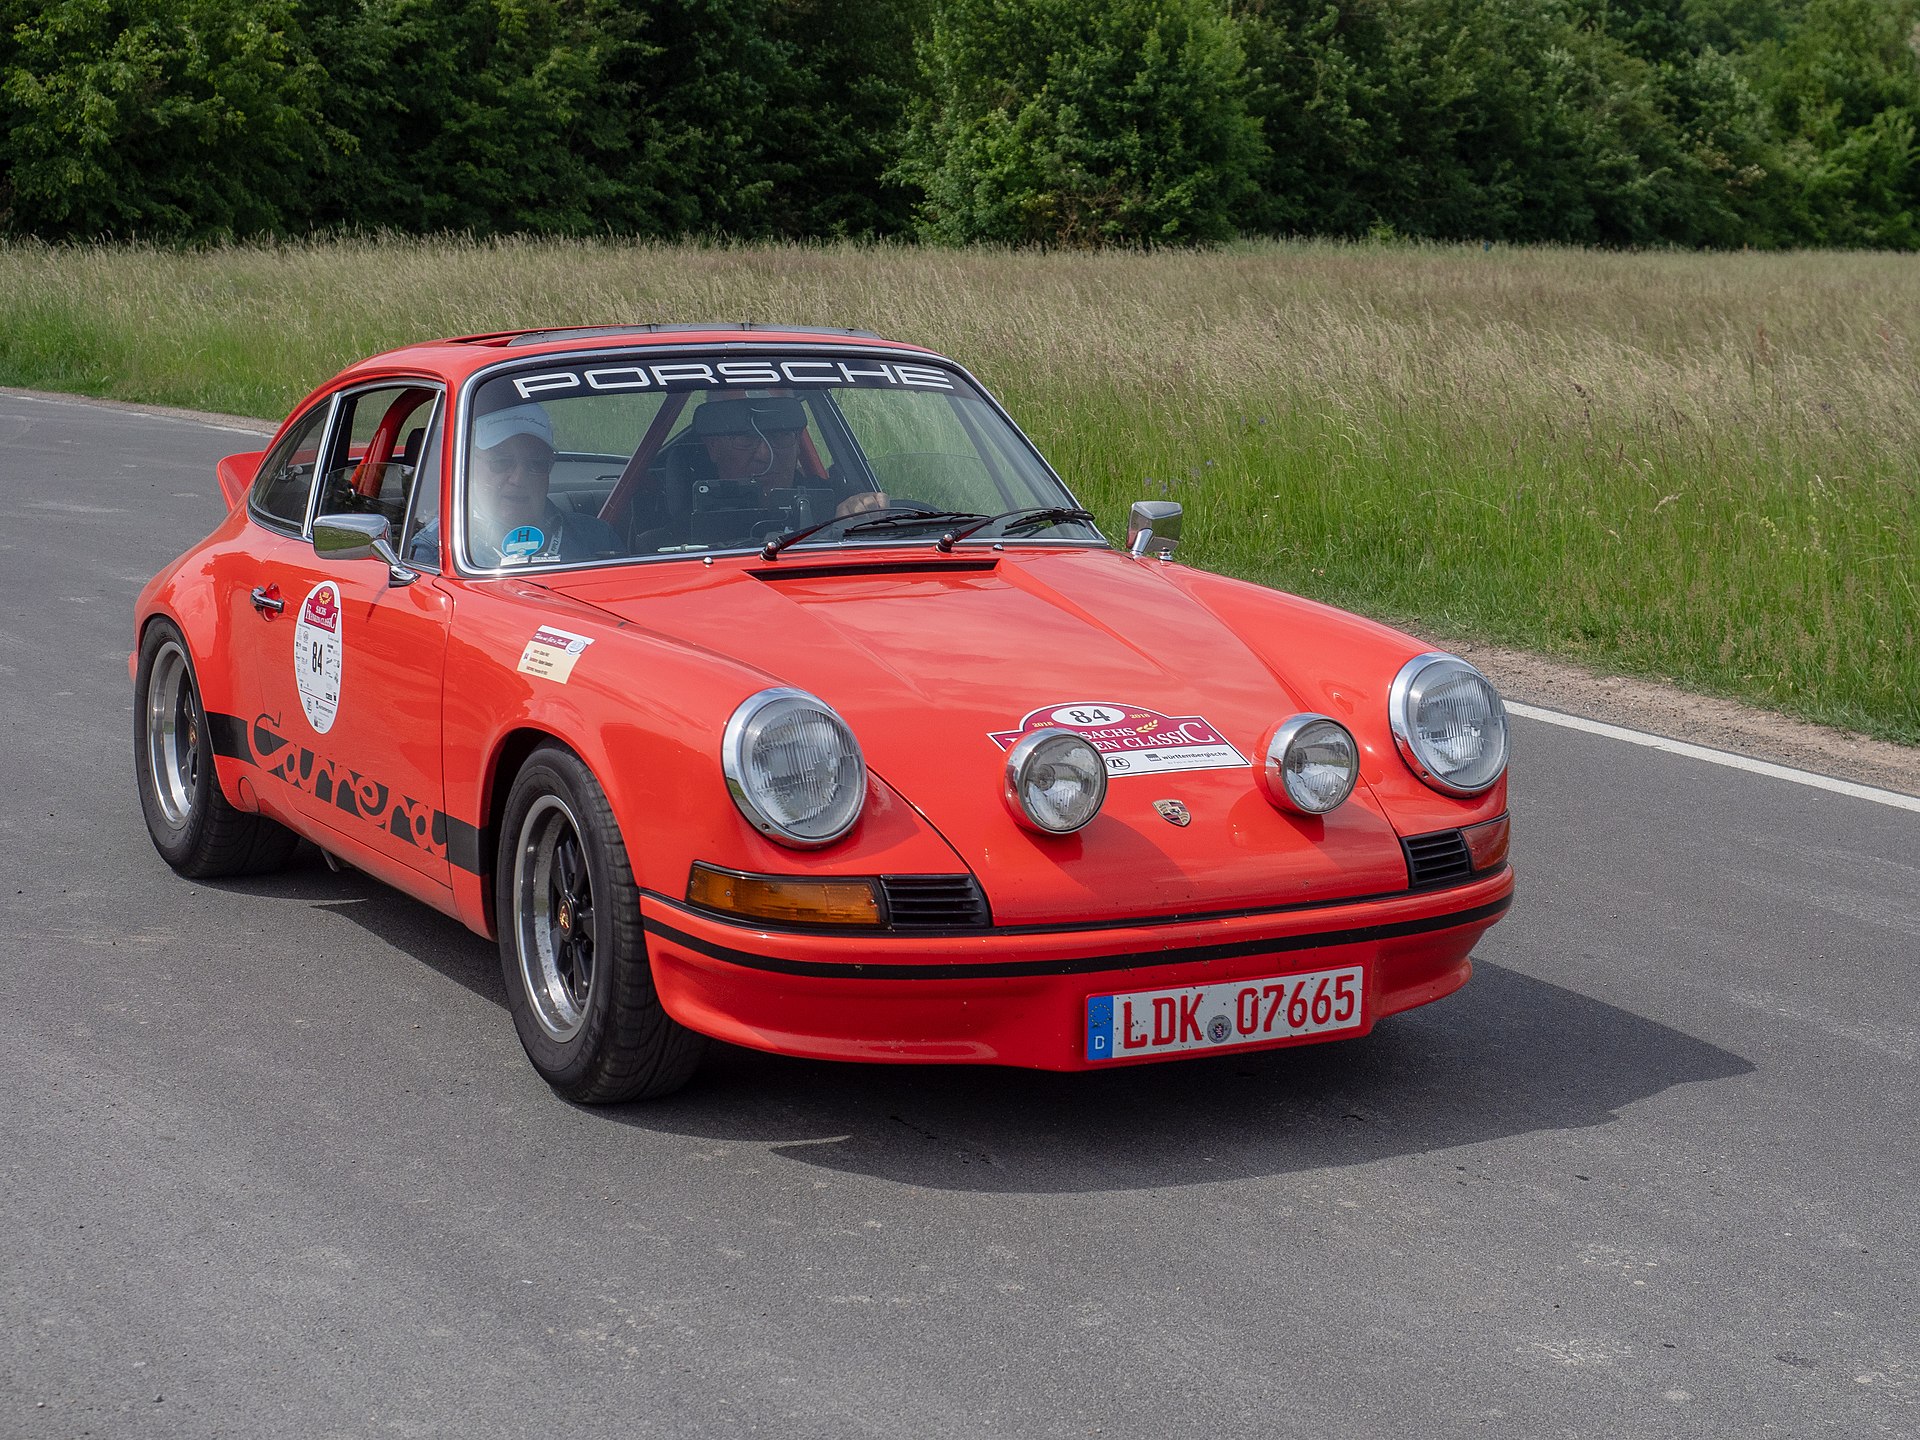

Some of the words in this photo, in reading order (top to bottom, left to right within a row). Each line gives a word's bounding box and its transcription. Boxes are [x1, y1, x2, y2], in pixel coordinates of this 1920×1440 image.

[513, 362, 954, 399] PORSCHE
[518, 530, 530, 542] H
[312, 641, 323, 676] 84
[1069, 709, 1111, 724] 84
[1080, 727, 1136, 740] SACHS
[1123, 722, 1216, 748] CLASSIC
[1109, 757, 1128, 769] ZF
[1162, 751, 1228, 760] württembergische
[246, 711, 448, 859] Carrera
[1123, 993, 1204, 1049] LDK
[1236, 974, 1355, 1035] 07665
[1095, 1035, 1105, 1050] D
